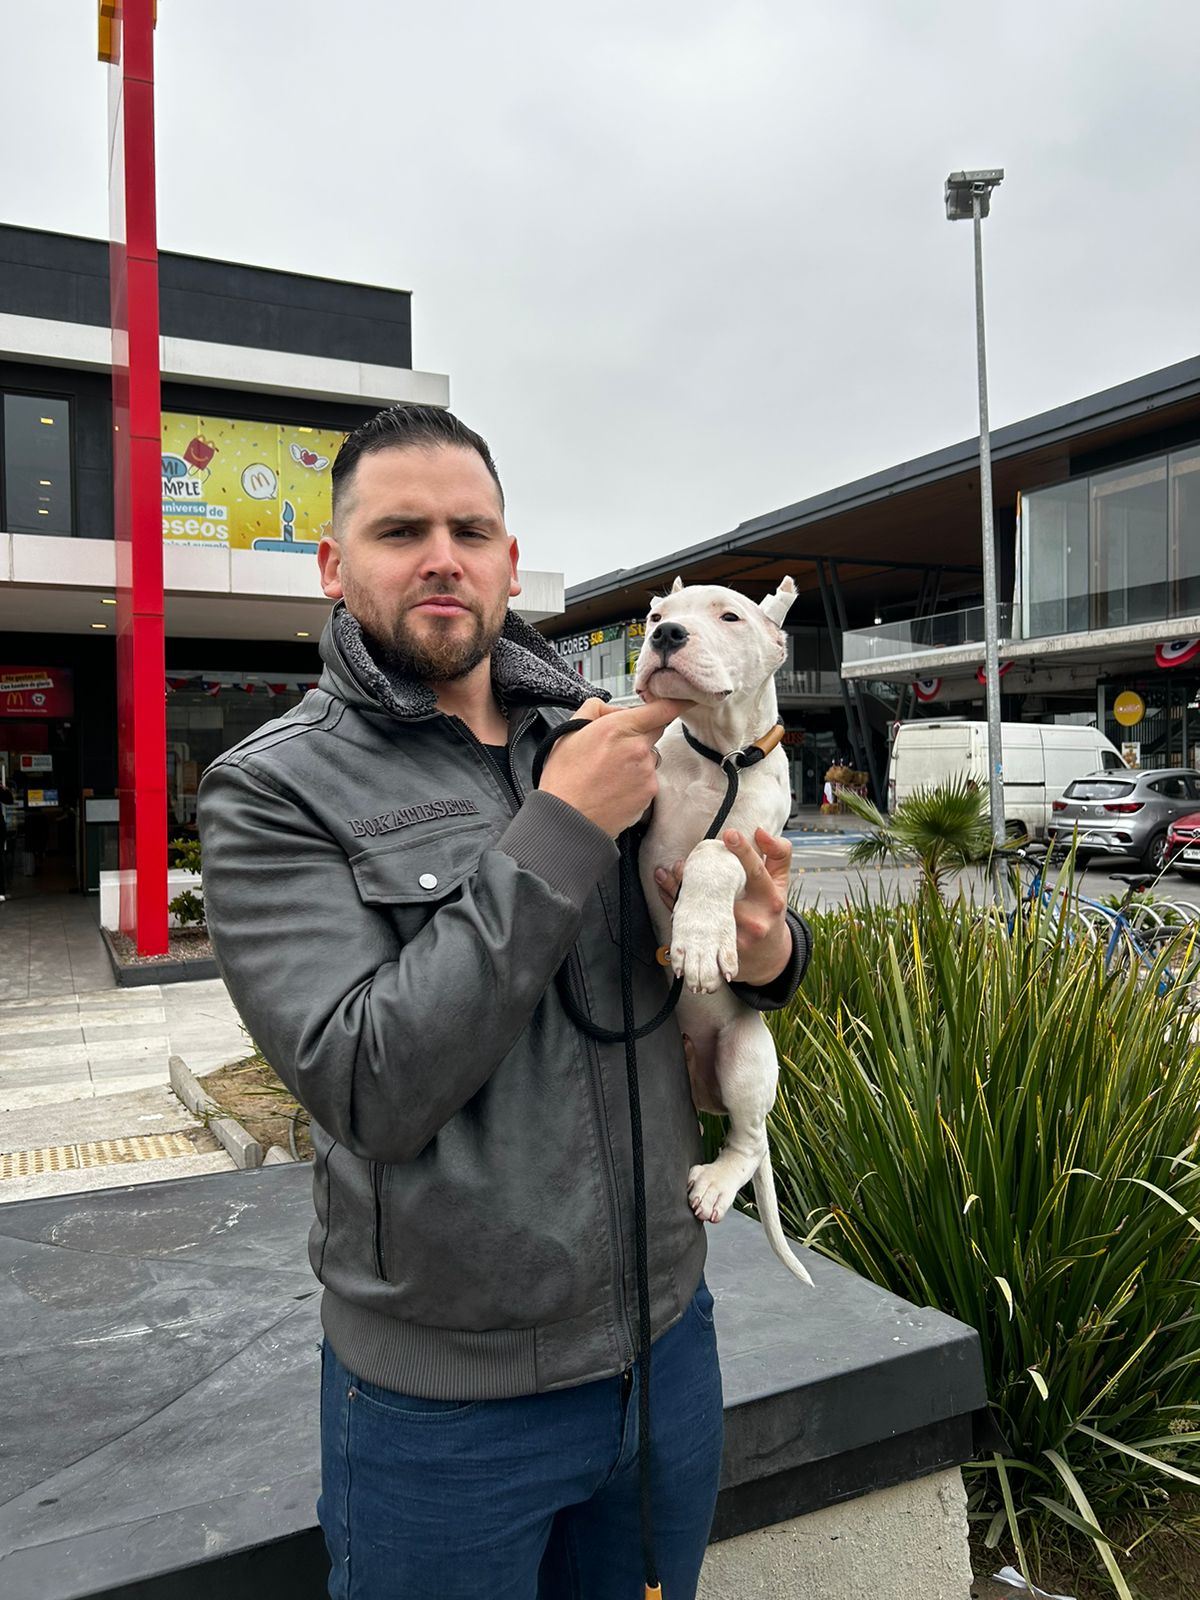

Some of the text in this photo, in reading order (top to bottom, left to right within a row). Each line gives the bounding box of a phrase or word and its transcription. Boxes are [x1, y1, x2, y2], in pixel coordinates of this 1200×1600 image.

[162, 462, 178, 475] MI
[164, 481, 200, 496] MPLE
[209, 507, 224, 517] de
[162, 519, 229, 540] eseos
